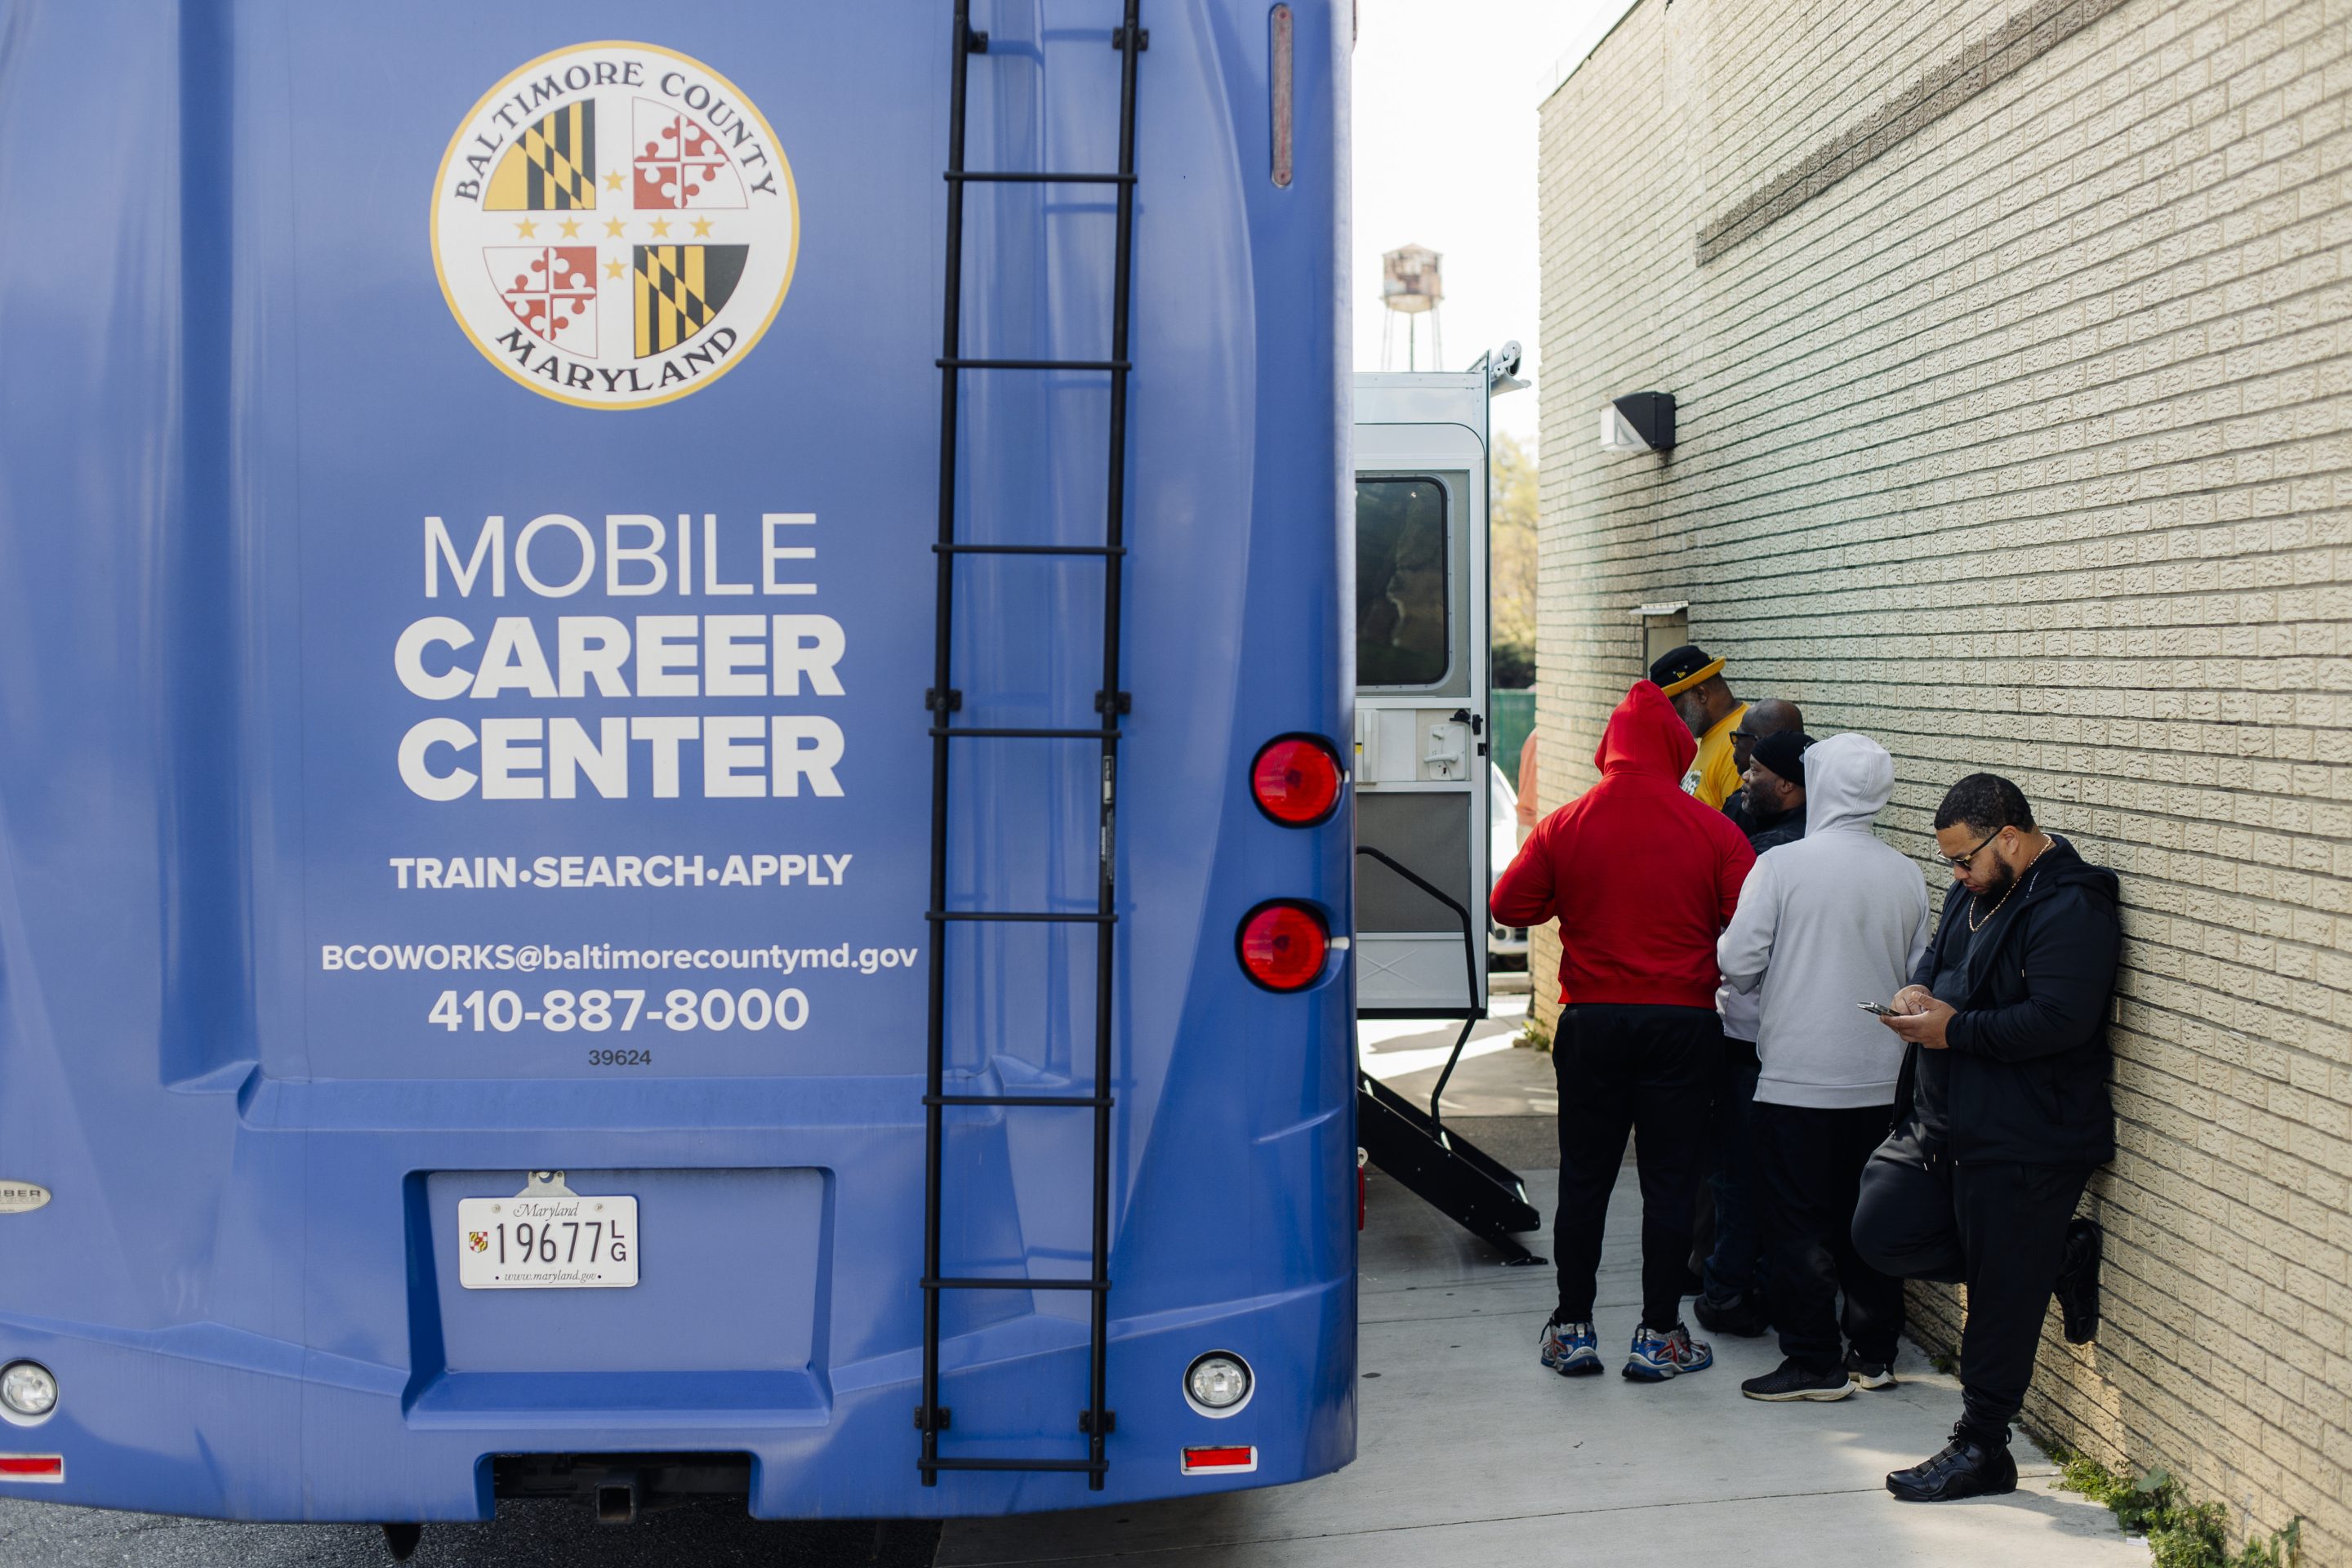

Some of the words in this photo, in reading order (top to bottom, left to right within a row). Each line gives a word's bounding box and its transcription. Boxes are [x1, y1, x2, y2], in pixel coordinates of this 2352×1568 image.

[454, 61, 645, 203] BALTIMORE
[660, 72, 777, 198] COUNTY
[495, 326, 737, 393] MARYLAND
[425, 513, 817, 598] MOBILE
[394, 614, 846, 700] CAREER
[398, 715, 844, 800] CENTER
[322, 942, 918, 975] BCOWORKS@baltimorecountymd.gov
[429, 988, 809, 1031] 410-887-8000
[588, 1049, 653, 1066] 39624
[513, 1202, 579, 1222] Maryland
[497, 1222, 603, 1263] 19677
[504, 1269, 597, 1283] www.maryland.gov
